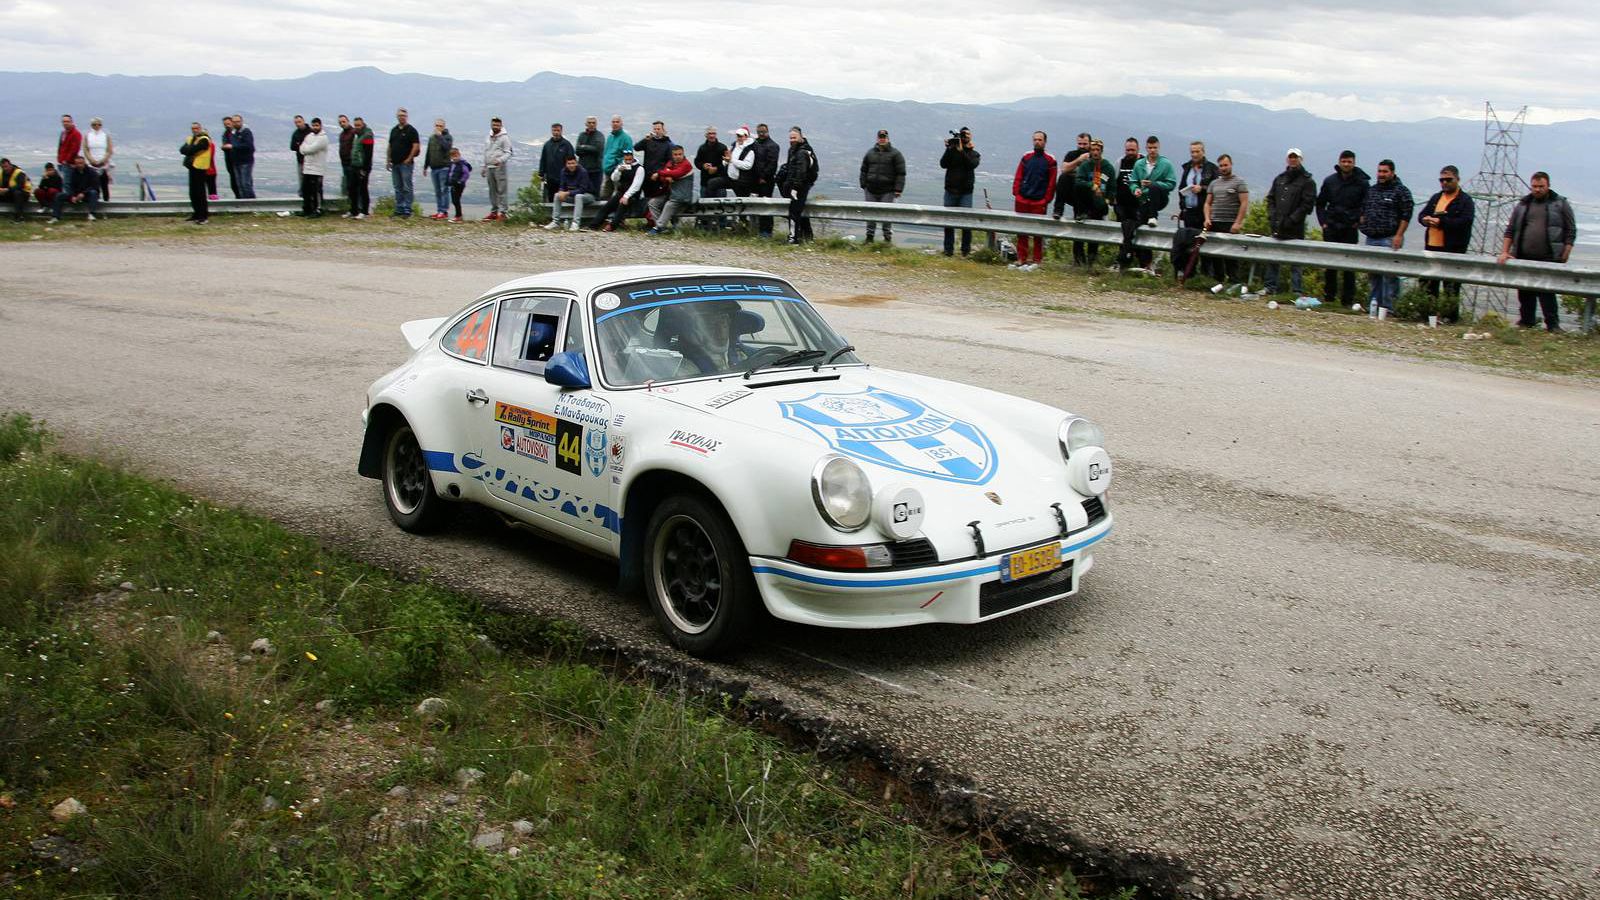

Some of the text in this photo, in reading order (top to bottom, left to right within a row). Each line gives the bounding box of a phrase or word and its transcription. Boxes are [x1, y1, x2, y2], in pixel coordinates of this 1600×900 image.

[628, 284, 784, 300] PORSCHE
[457, 311, 493, 359] 44
[508, 411, 526, 425] Rally
[527, 415, 549, 431] Sprint
[835, 414, 951, 440] ΑΠΟΛΛΩΝ
[516, 435, 549, 460] AUTOVISION
[558, 432, 580, 467] 44
[924, 447, 960, 460] 1891
[454, 448, 606, 526] Carrera
